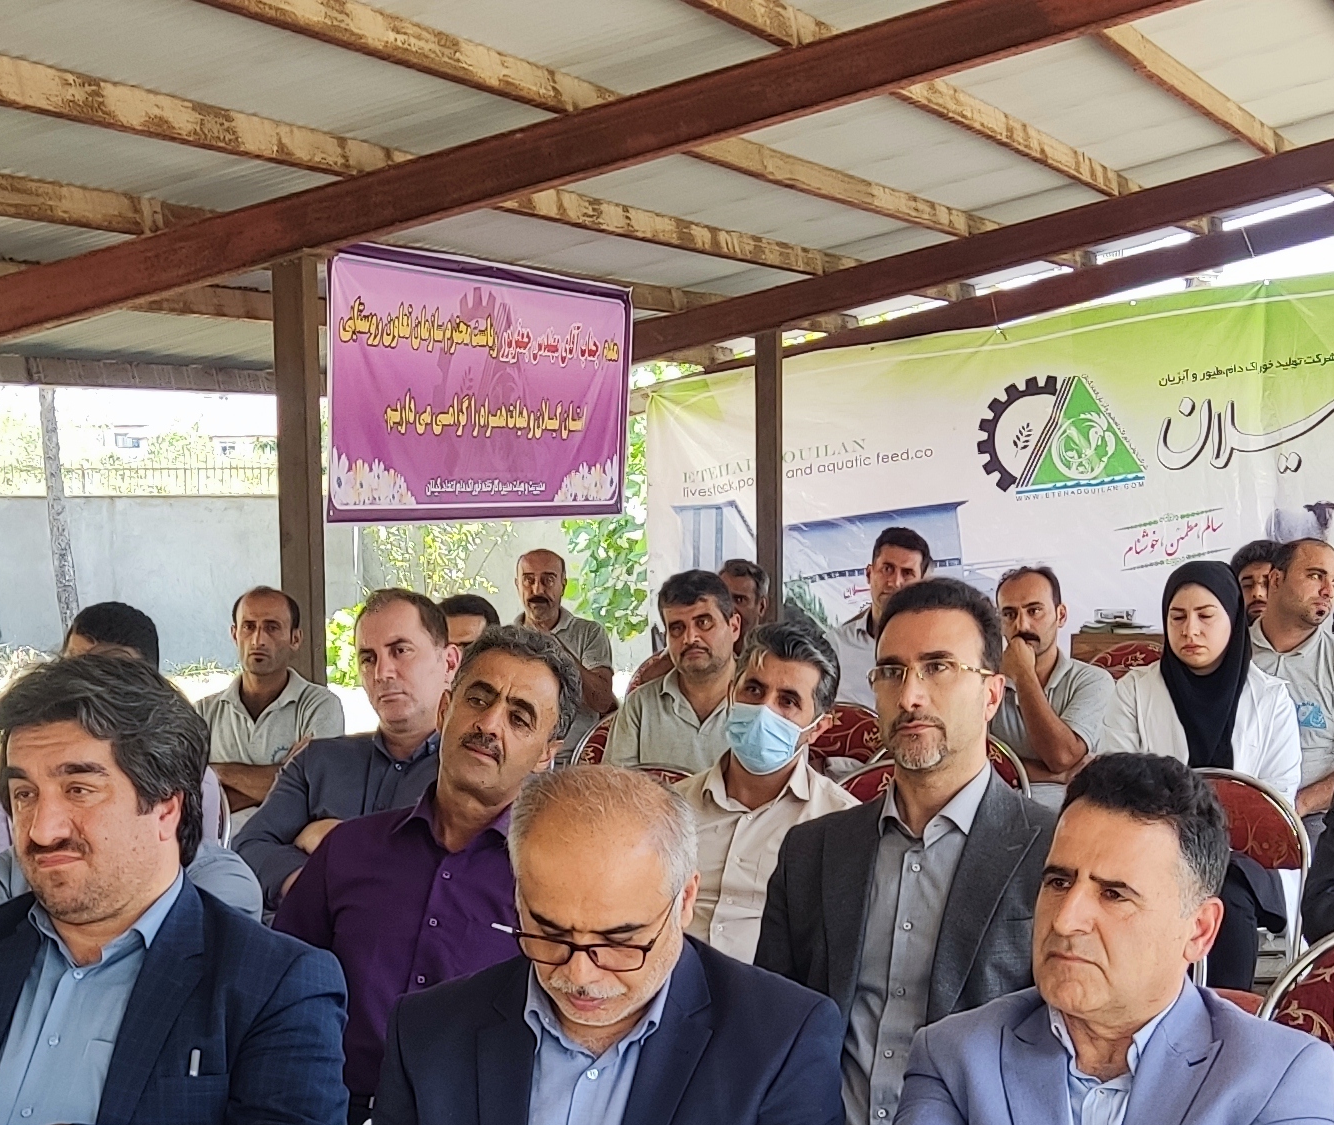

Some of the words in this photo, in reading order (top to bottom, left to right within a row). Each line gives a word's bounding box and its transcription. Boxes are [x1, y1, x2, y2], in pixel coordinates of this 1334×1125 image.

[382, 301, 413, 349] تعاون
[411, 305, 444, 353] سازمان
[1158, 368, 1190, 387] آبزیان
[1191, 373, 1198, 382] و
[1245, 359, 1274, 375] خوراک
[1275, 357, 1304, 370] تولید
[433, 393, 470, 436] گرامی
[470, 393, 479, 437] را
[479, 394, 506, 438] همراه
[534, 397, 562, 440] گیلان
[682, 458, 752, 484] ETEHA
[786, 463, 813, 479] and
[817, 454, 872, 474] aquatic
[875, 447, 934, 466] feed.co
